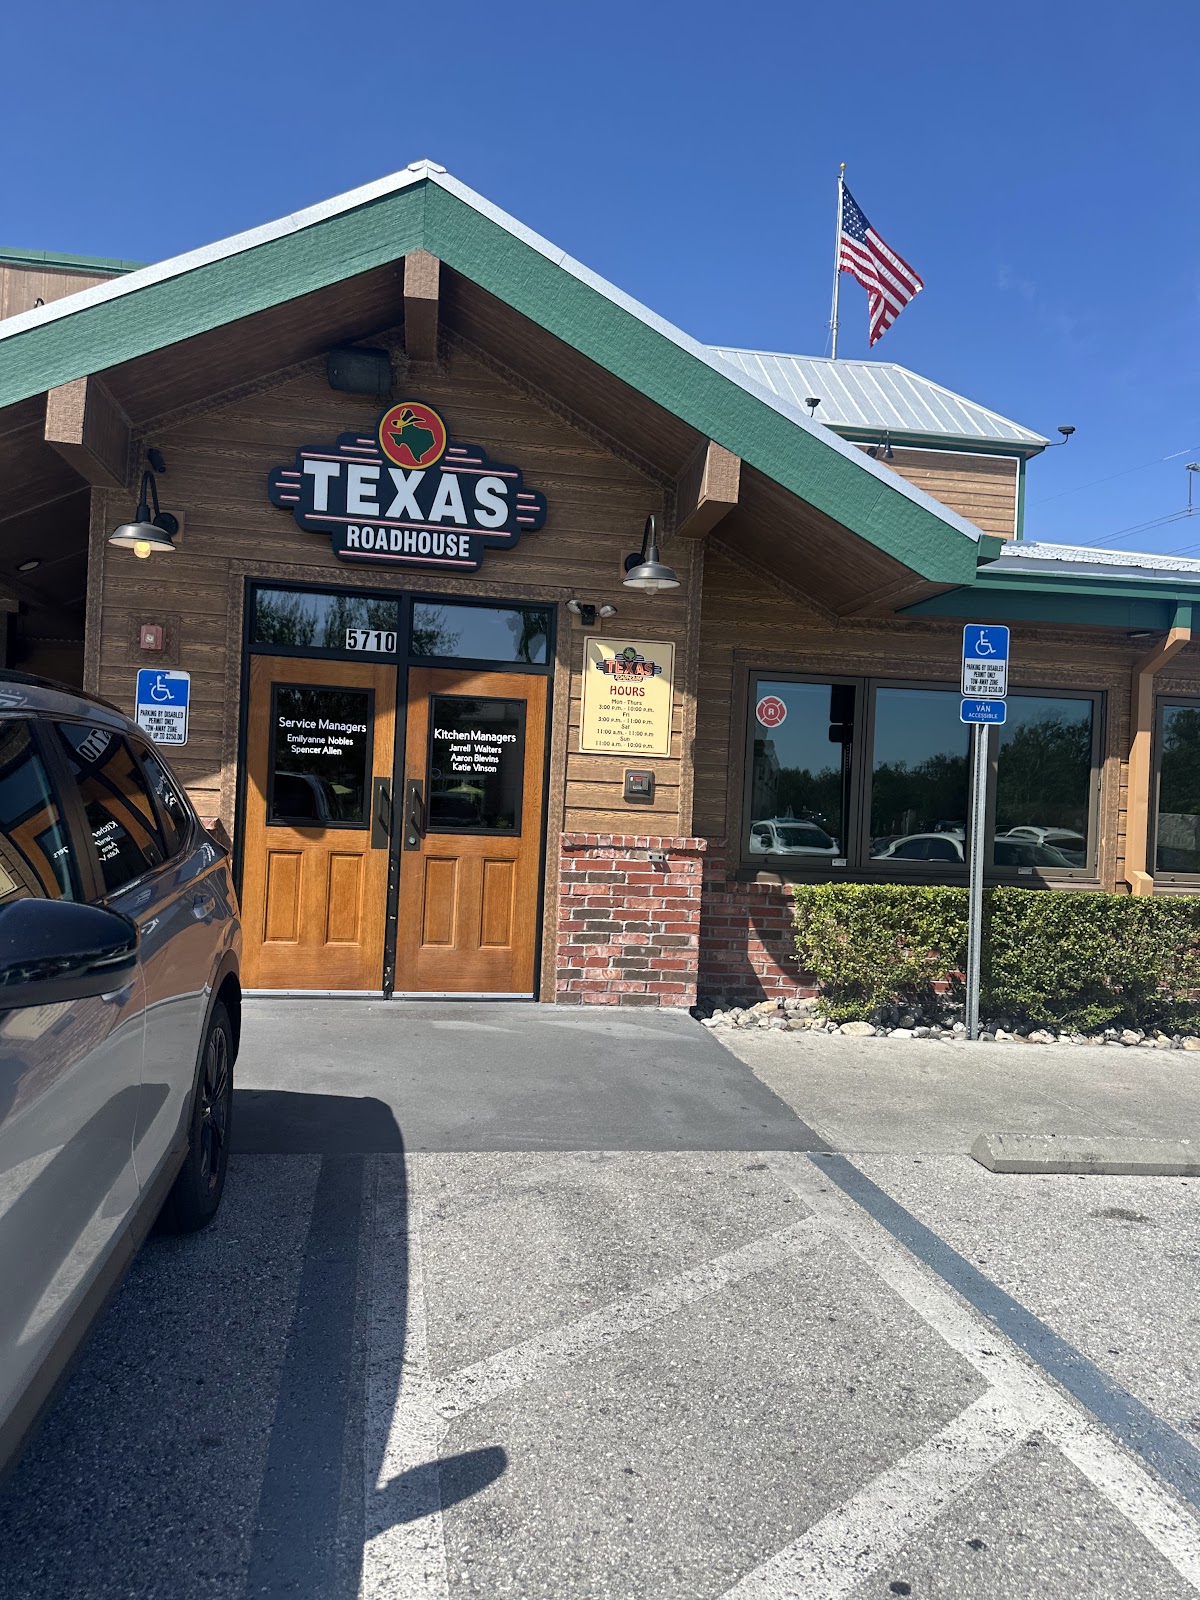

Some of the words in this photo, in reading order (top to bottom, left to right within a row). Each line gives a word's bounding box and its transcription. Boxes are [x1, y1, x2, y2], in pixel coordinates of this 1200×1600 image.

[304, 460, 508, 528] TEXAS
[347, 525, 470, 557] ROADHOUSE
[347, 631, 396, 652] 5710
[606, 660, 653, 675] TEXAS
[610, 685, 646, 696] HOURS
[279, 716, 316, 729] Service
[318, 718, 366, 734] Managers
[287, 734, 326, 744] Emilyanne
[328, 736, 354, 746] Nobles
[434, 728, 470, 740] Kitchen
[470, 730, 516, 744] Managers
[291, 744, 322, 754] Spencer
[322, 746, 342, 755] Allen
[449, 744, 471, 752] Jarrell
[474, 744, 502, 754] Walters
[450, 753, 472, 762] Aaron
[474, 754, 499, 763] Blevins
[452, 762, 471, 772] Katie
[473, 763, 496, 772] Vinson
